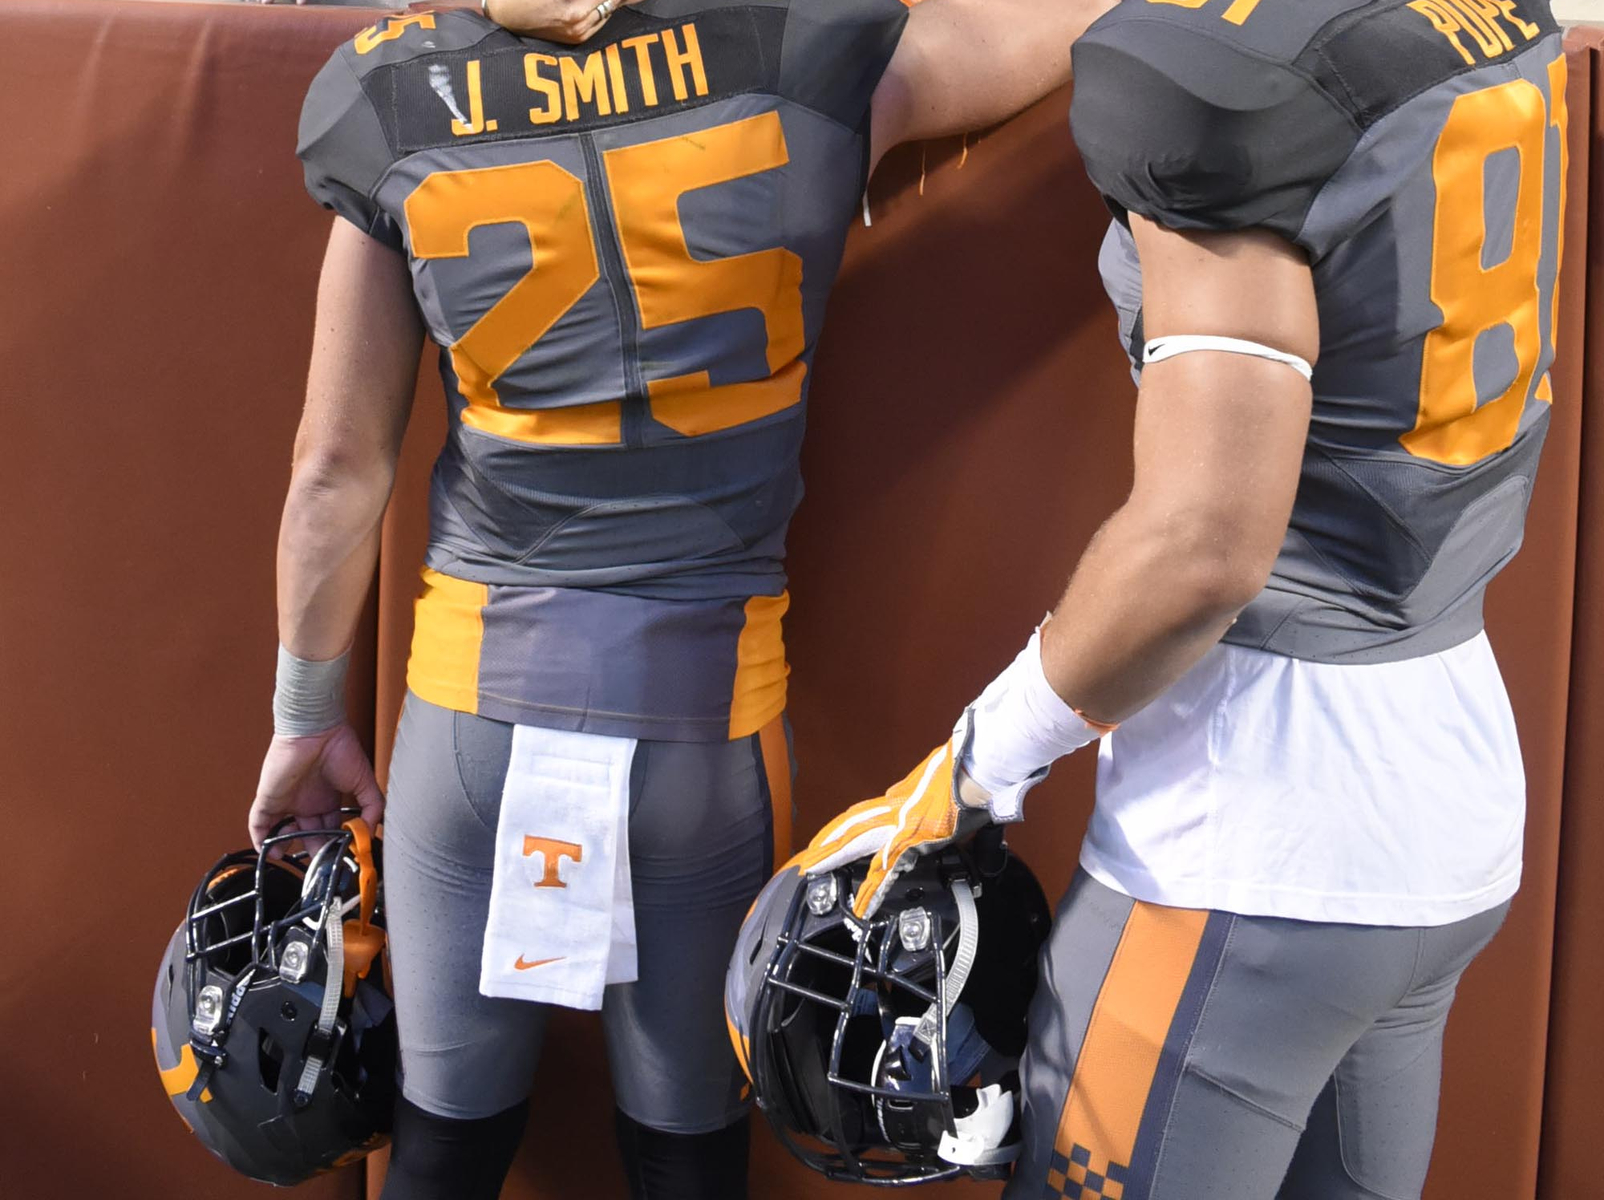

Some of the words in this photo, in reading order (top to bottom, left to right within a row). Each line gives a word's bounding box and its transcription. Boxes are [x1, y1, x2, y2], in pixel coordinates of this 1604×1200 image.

[451, 59, 498, 136] J.
[524, 23, 709, 125] SMITH
[403, 110, 806, 445] 25
[522, 834, 583, 889] T
